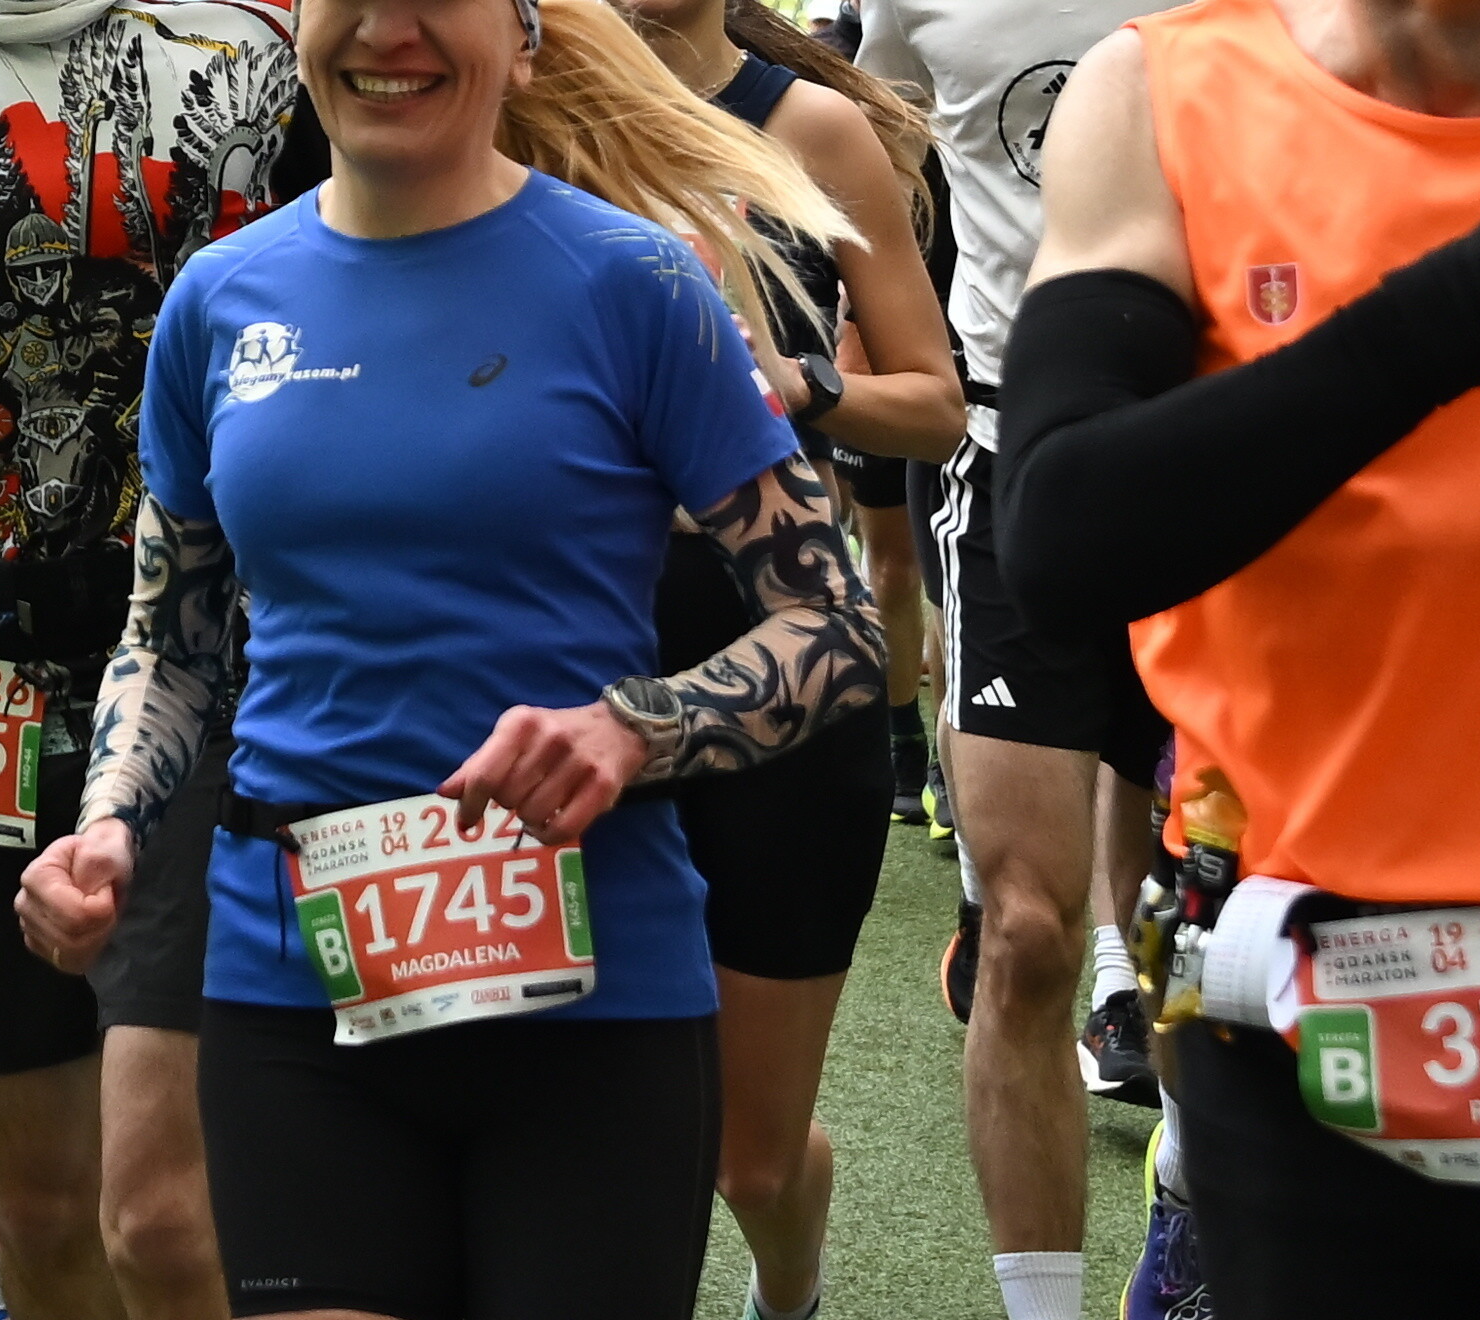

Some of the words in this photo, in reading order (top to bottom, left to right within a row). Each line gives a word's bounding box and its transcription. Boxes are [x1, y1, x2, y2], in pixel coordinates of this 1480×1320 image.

[300, 819, 365, 846] ENERGA
[379, 811, 406, 835] 19
[311, 836, 367, 861] GDAŃSK
[312, 852, 369, 874] MARATON
[381, 833, 410, 857] 04
[314, 927, 349, 977] B
[354, 857, 547, 956] 1745
[1319, 926, 1409, 951] ENERGA
[1429, 921, 1463, 948] 19
[390, 940, 522, 982] MAGDALENA
[1333, 949, 1412, 970] GDAŃSK
[1334, 966, 1417, 987] MARATON
[1431, 947, 1467, 975] 04
[1318, 1046, 1367, 1103] B
